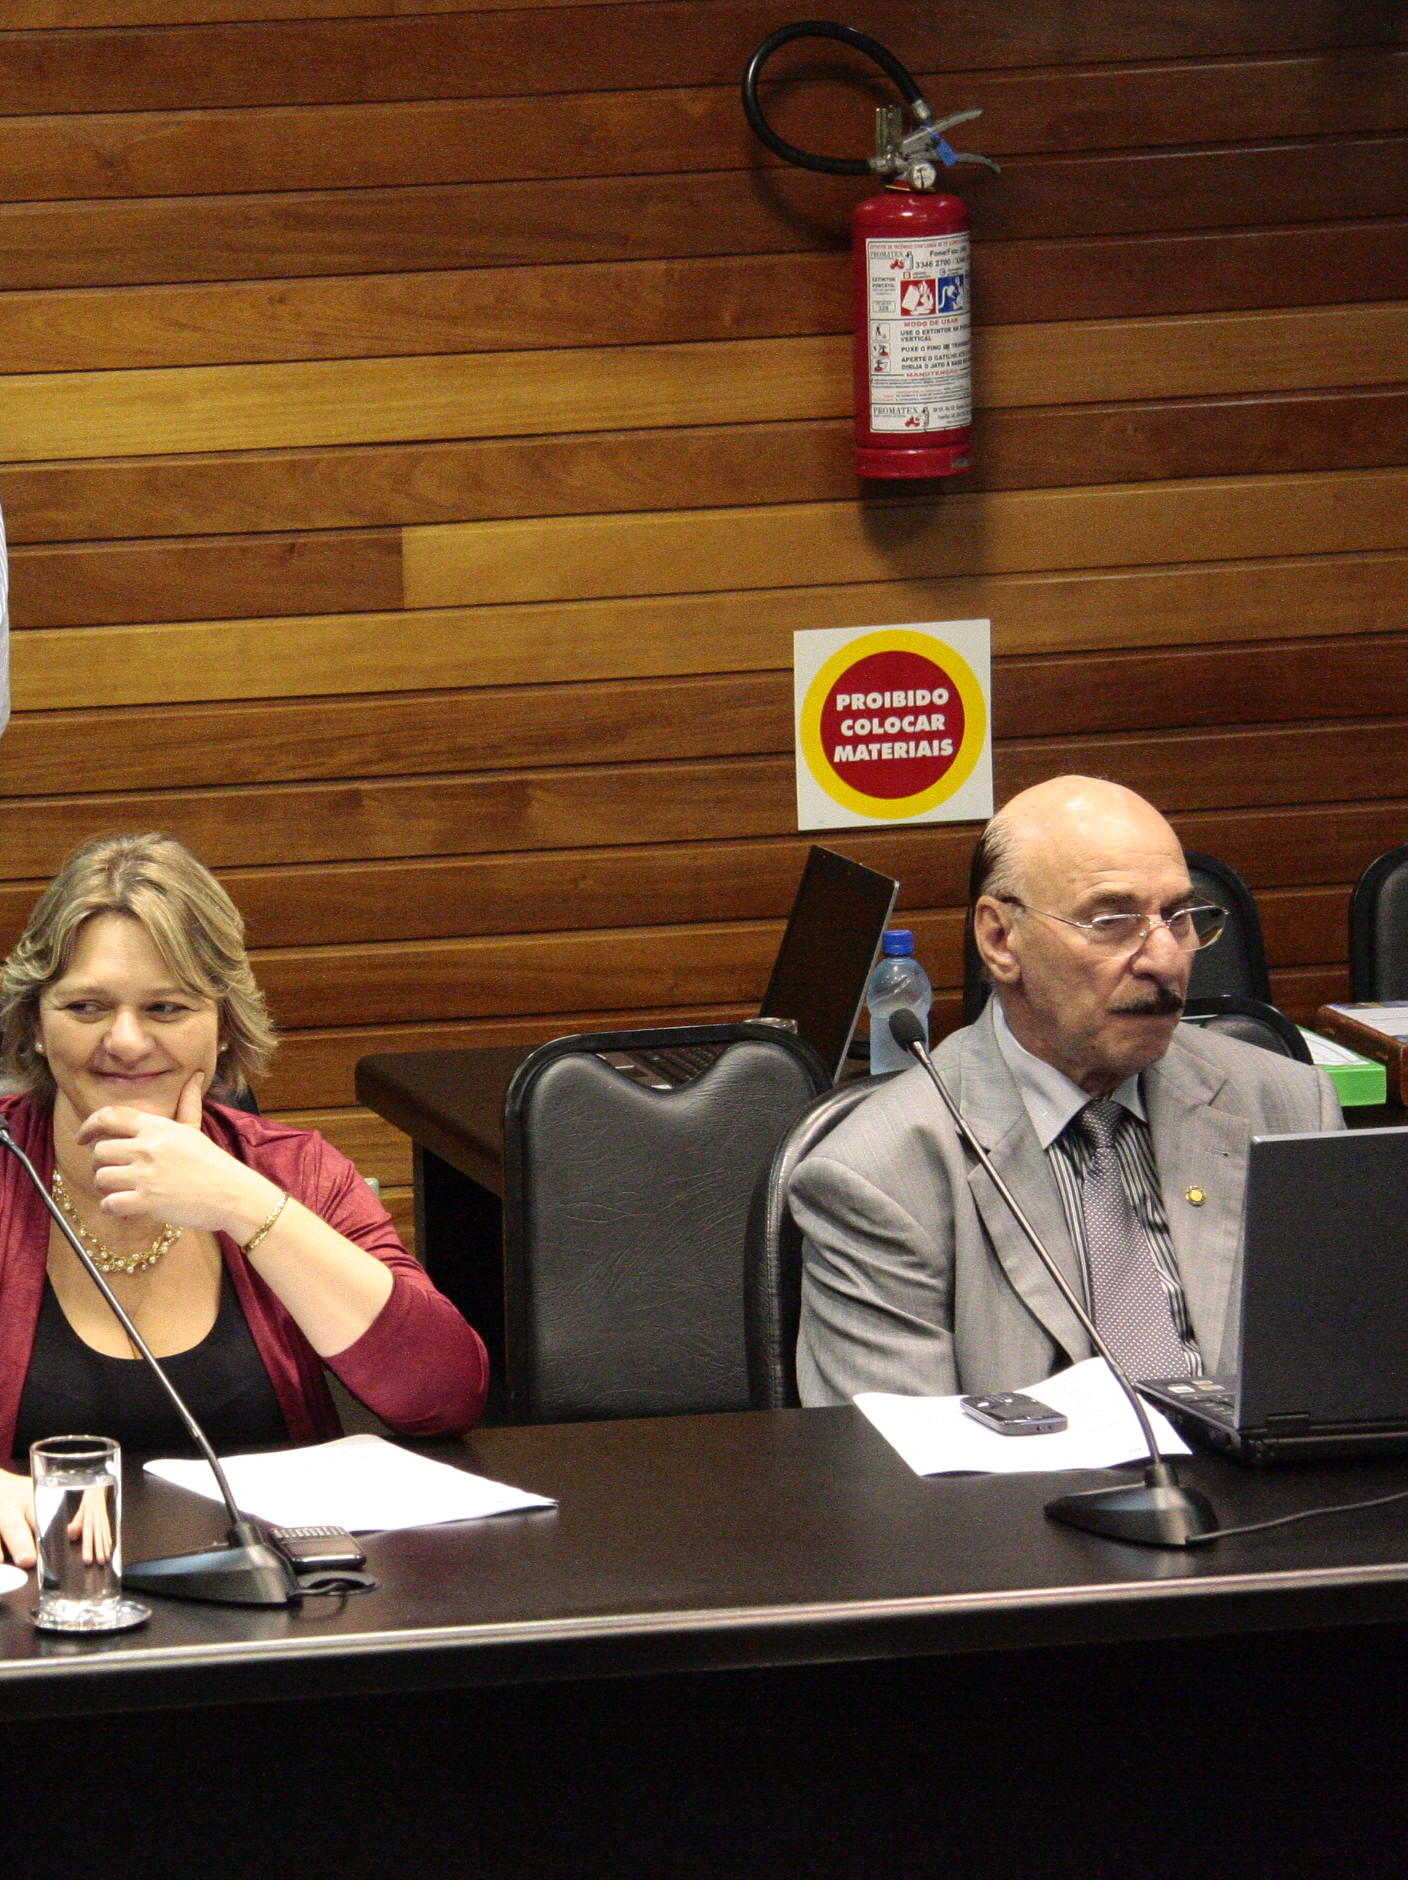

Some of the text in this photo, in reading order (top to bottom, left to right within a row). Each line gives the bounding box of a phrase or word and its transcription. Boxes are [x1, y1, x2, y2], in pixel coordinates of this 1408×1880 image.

[922, 327, 952, 335] EXTINTOR
[873, 406, 919, 415] PROMATEX
[836, 688, 950, 711] PROIBIDO
[840, 714, 946, 737] COLOCAR
[833, 738, 954, 763] MATERIAIS
